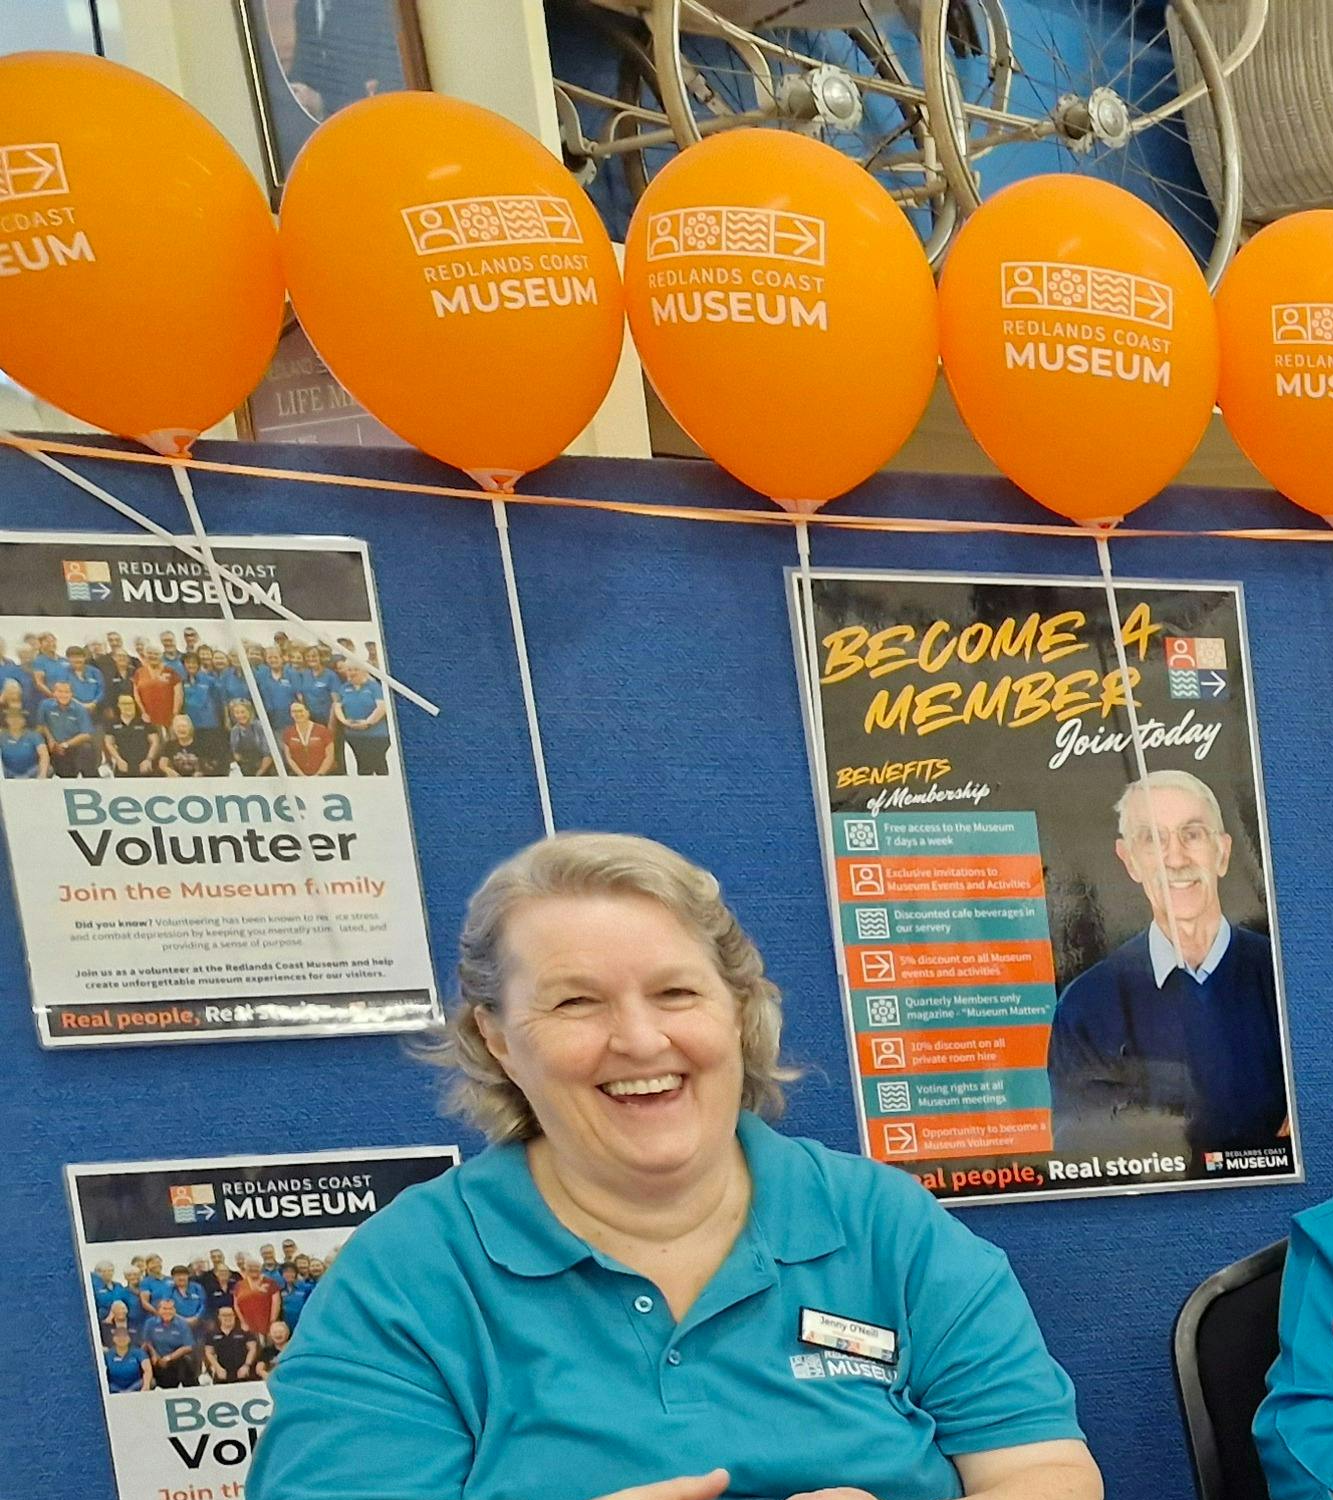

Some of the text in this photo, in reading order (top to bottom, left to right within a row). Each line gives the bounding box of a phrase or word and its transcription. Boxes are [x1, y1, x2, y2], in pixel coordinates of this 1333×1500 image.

[424, 254, 590, 283] REDLANDS COAST
[648, 268, 826, 294] REDLANDS COAST
[430, 276, 599, 318] MUSEUM
[650, 291, 828, 332] MUSEUM
[1003, 319, 1173, 355] REDLANDS COAST
[1005, 342, 1171, 388] MUSEUM
[276, 387, 324, 417] LIFE
[820, 602, 1163, 685] BECOME A
[864, 666, 1142, 735] MEMBER
[1049, 709, 1222, 770] Join today
[835, 757, 952, 789] BENEFITS
[63, 787, 354, 827] Become a
[867, 781, 991, 817] of Membership
[68, 827, 358, 867] Volunteer
[59, 879, 296, 903] Join the Museum
[61, 1006, 201, 1030] Real people,
[905, 993, 999, 1008] Quarterly Members
[951, 1151, 1187, 1192] people, Real stories
[1225, 1155, 1289, 1171] MUSEUM
[222, 1174, 373, 1195] REDLANDS COAST
[224, 1190, 377, 1222] MUSEUM
